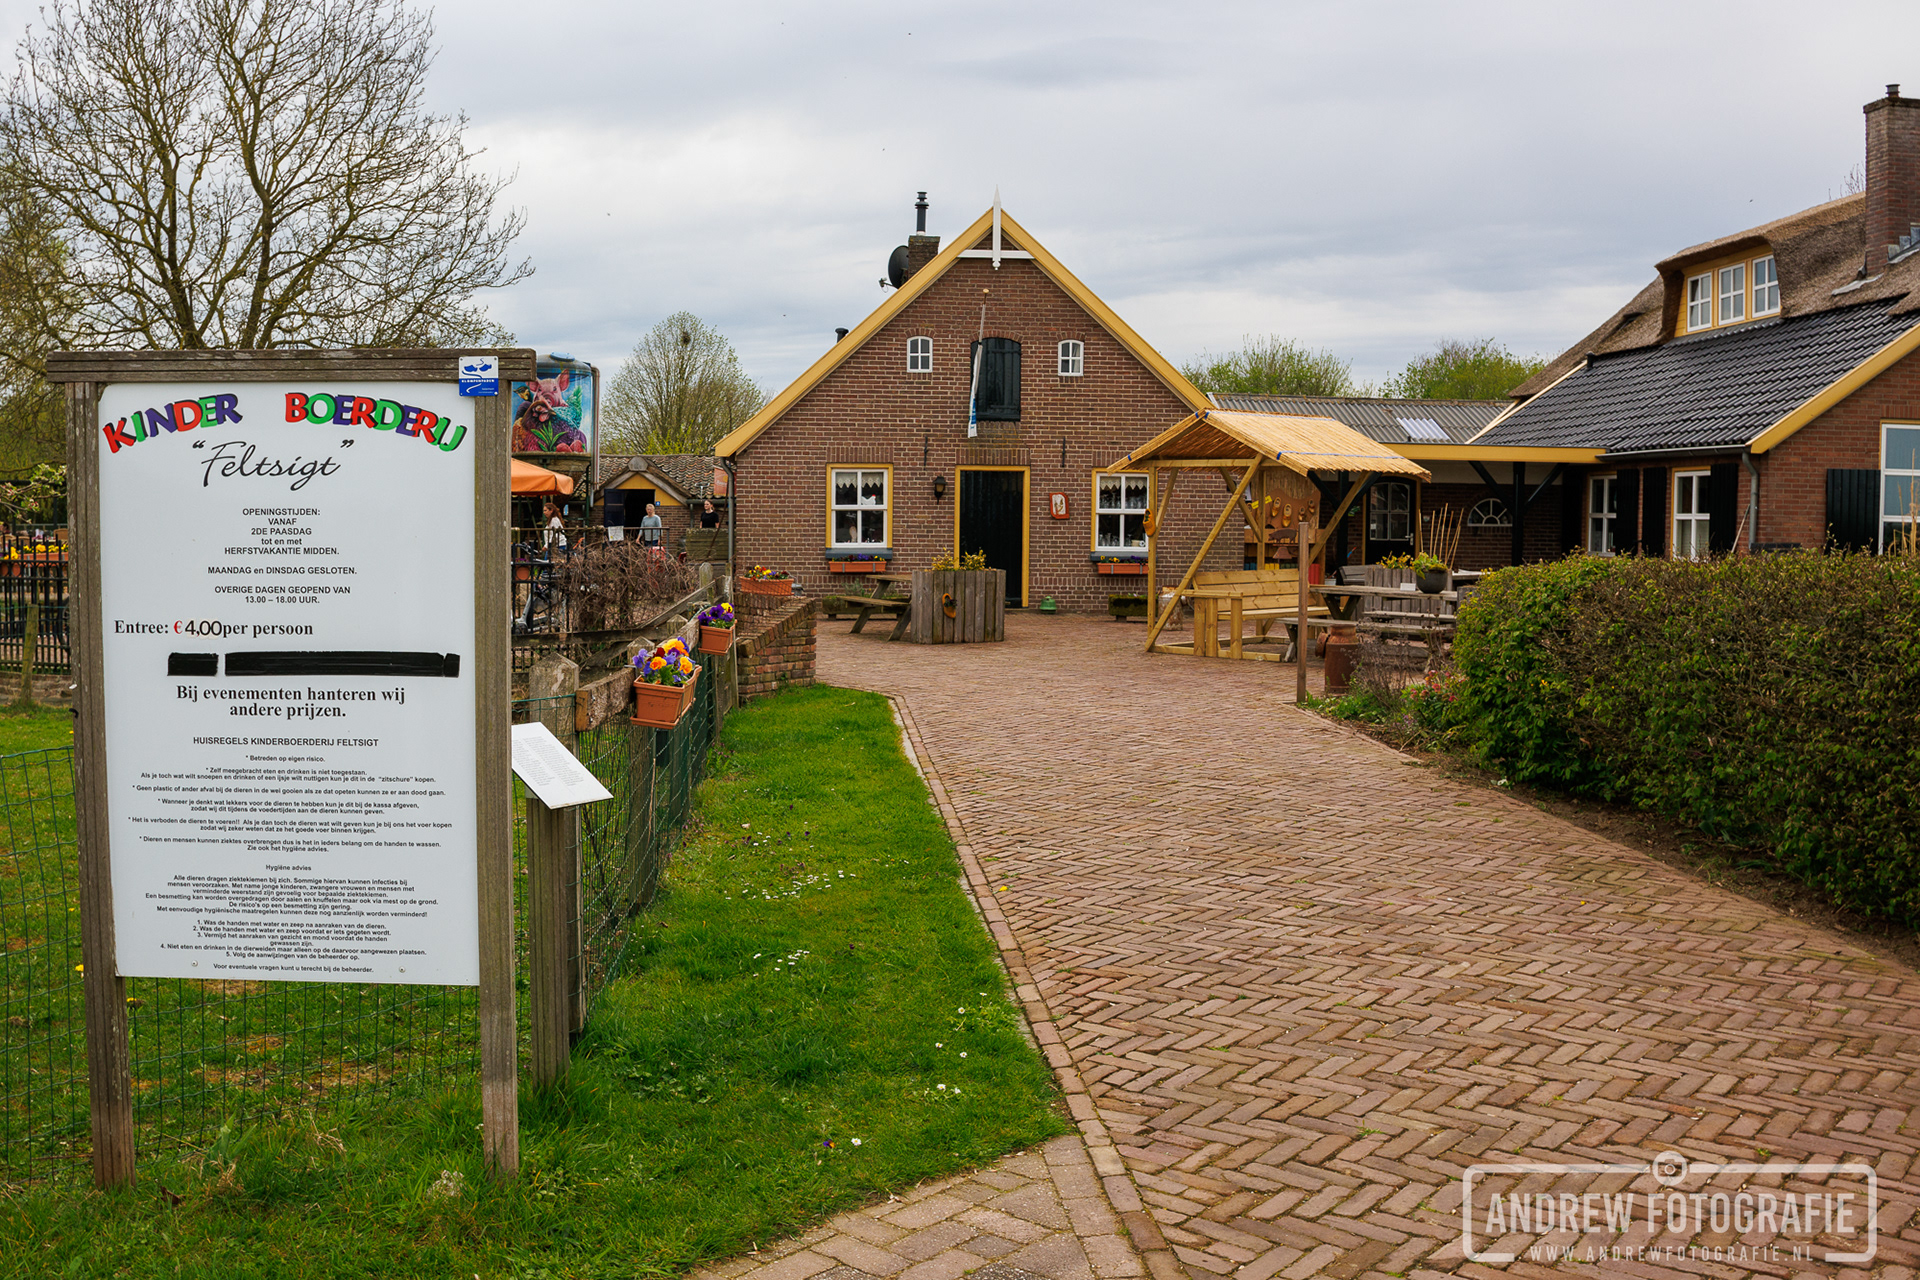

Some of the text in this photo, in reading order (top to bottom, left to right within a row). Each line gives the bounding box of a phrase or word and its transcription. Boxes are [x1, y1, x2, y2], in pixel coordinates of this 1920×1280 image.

[102, 392, 467, 453] KINDER BOERDERIJ
[268, 517, 297, 525] VANAF
[114, 620, 169, 634] Entree:
[252, 624, 313, 638] persoon
[177, 686, 405, 705] Bij evenementen hanteren wij
[230, 702, 346, 721] andere prijzen.
[193, 737, 379, 746] HUISREGELS KINDERBOERDERIJ FELTSIGT
